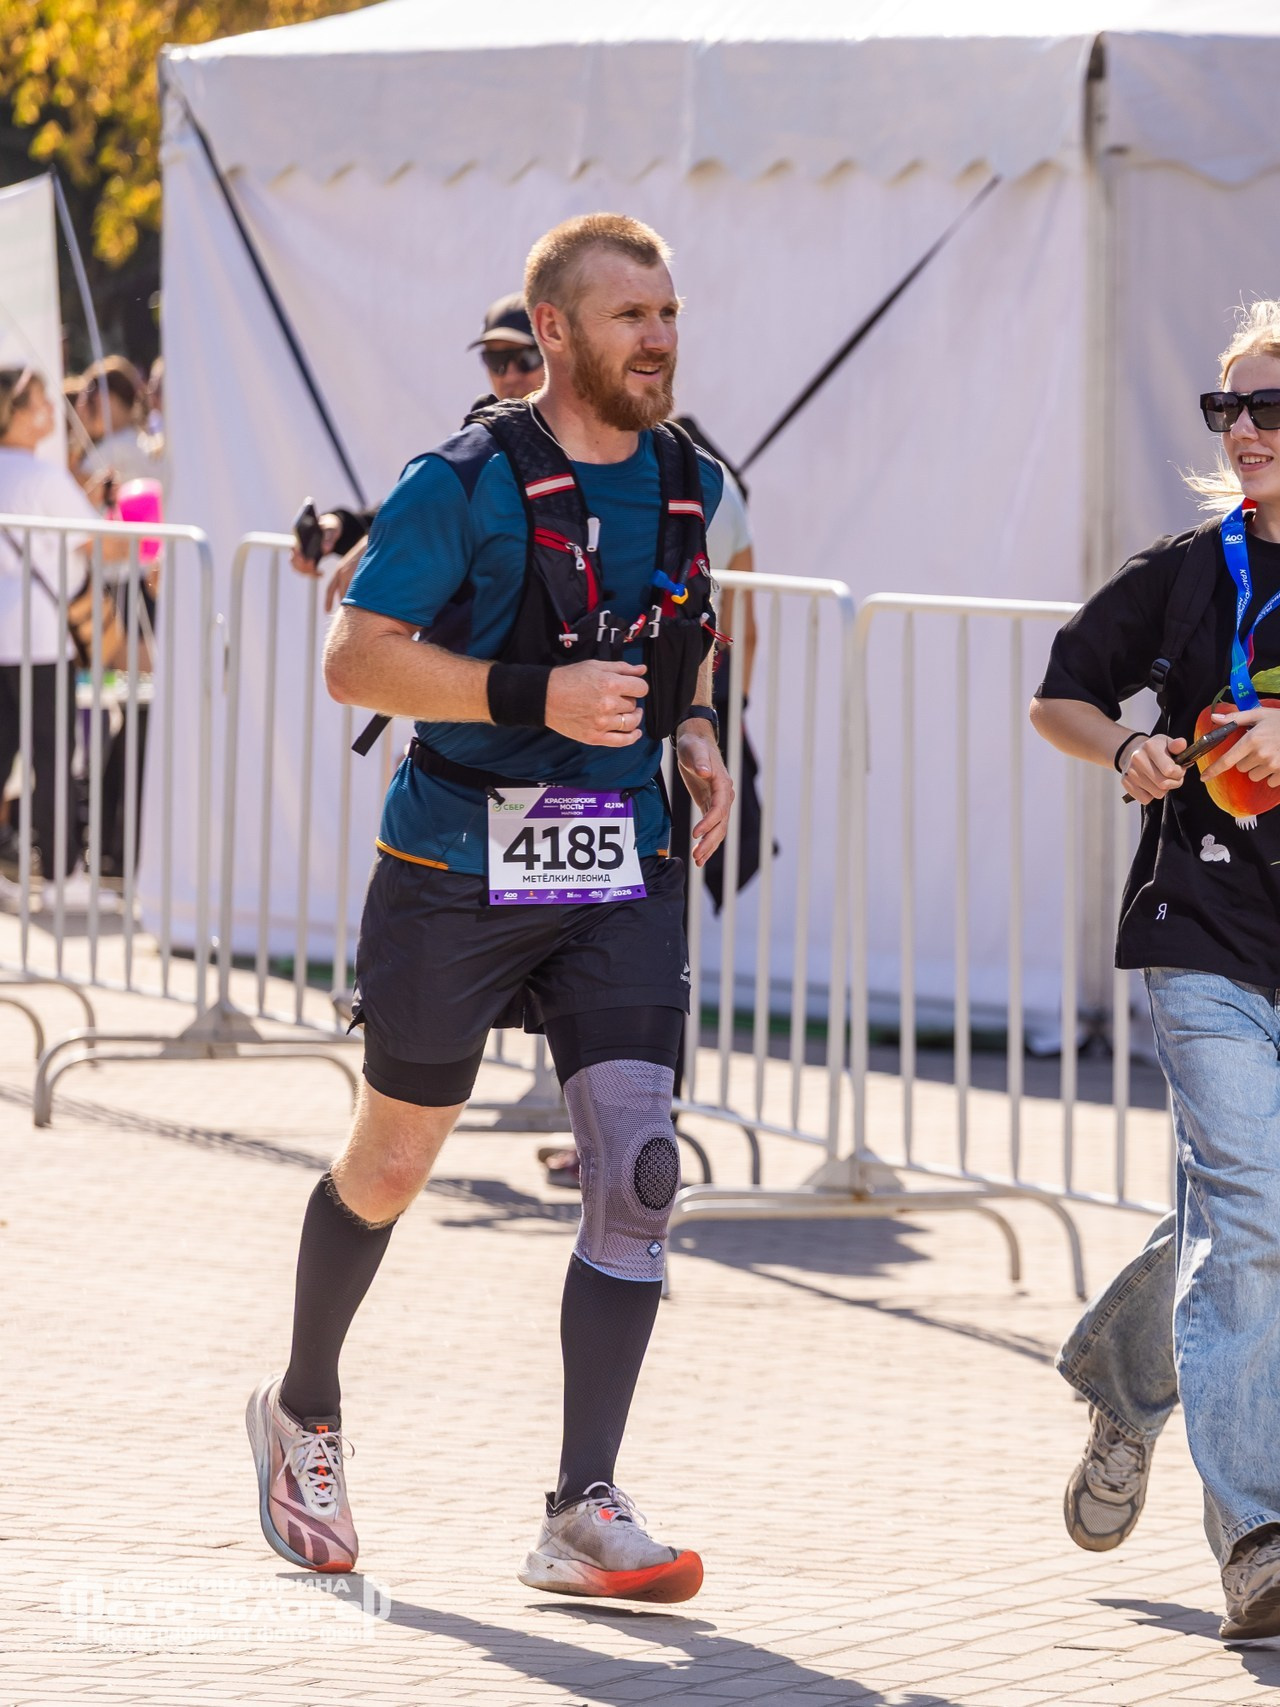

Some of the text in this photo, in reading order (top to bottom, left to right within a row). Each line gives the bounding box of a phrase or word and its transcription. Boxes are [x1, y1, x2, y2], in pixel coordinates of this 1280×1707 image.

[1225, 534, 1243, 542] 400
[1237, 682, 1244, 690] 5
[502, 825, 624, 871] 4185
[522, 873, 611, 883] МЕТЁЛКИН ЛЕОНИД
[612, 889, 632, 897] 2026
